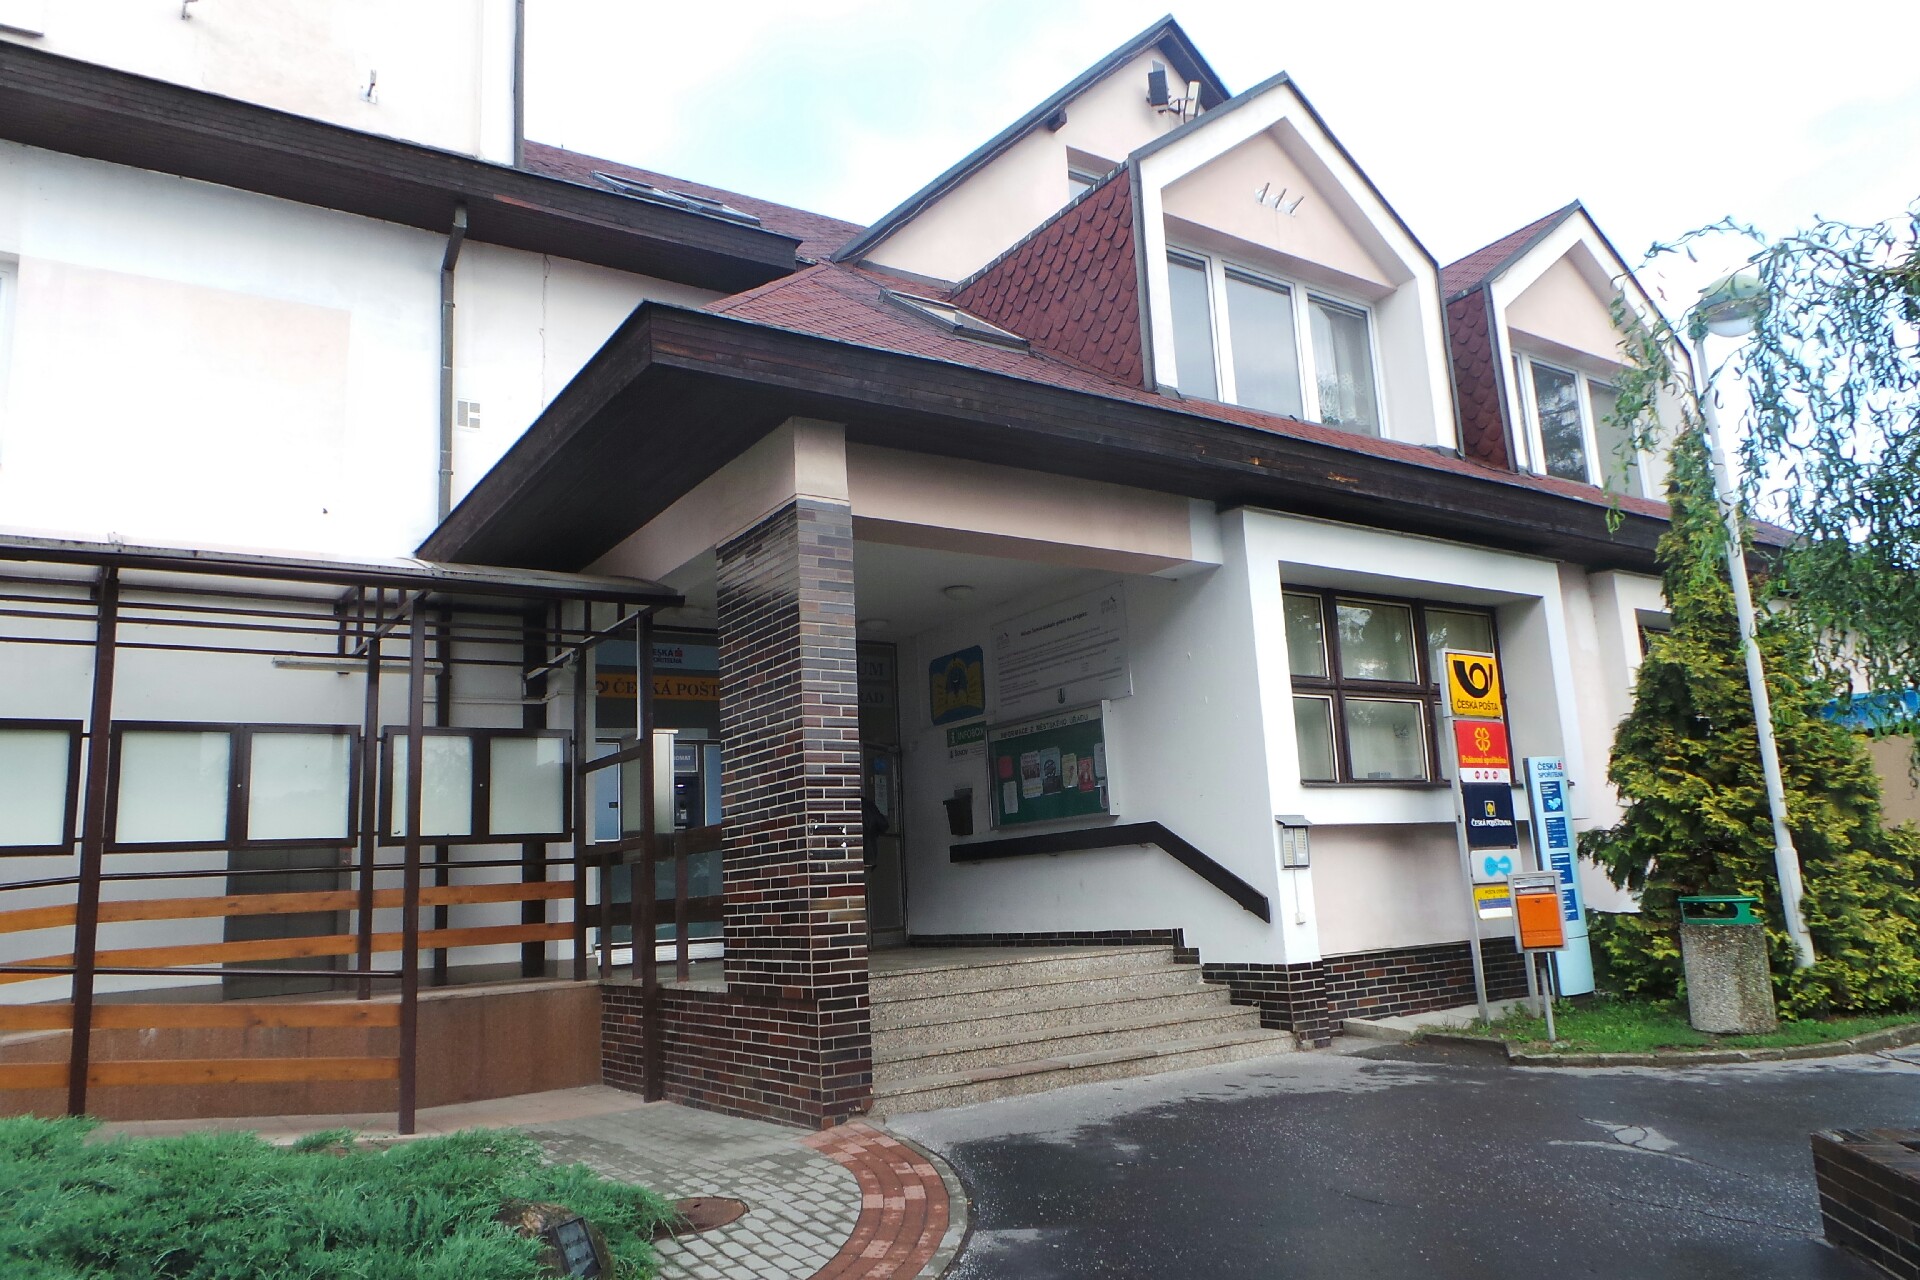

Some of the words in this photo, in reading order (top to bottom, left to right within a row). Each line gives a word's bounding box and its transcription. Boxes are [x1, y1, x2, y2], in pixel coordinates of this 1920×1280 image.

[653, 647, 674, 657] ESKÁ
[613, 678, 672, 696] ČEKÁ
[676, 681, 720, 697] POŠT
[1456, 699, 1478, 709] ČESKÁ
[1478, 701, 1499, 711] POŠTA
